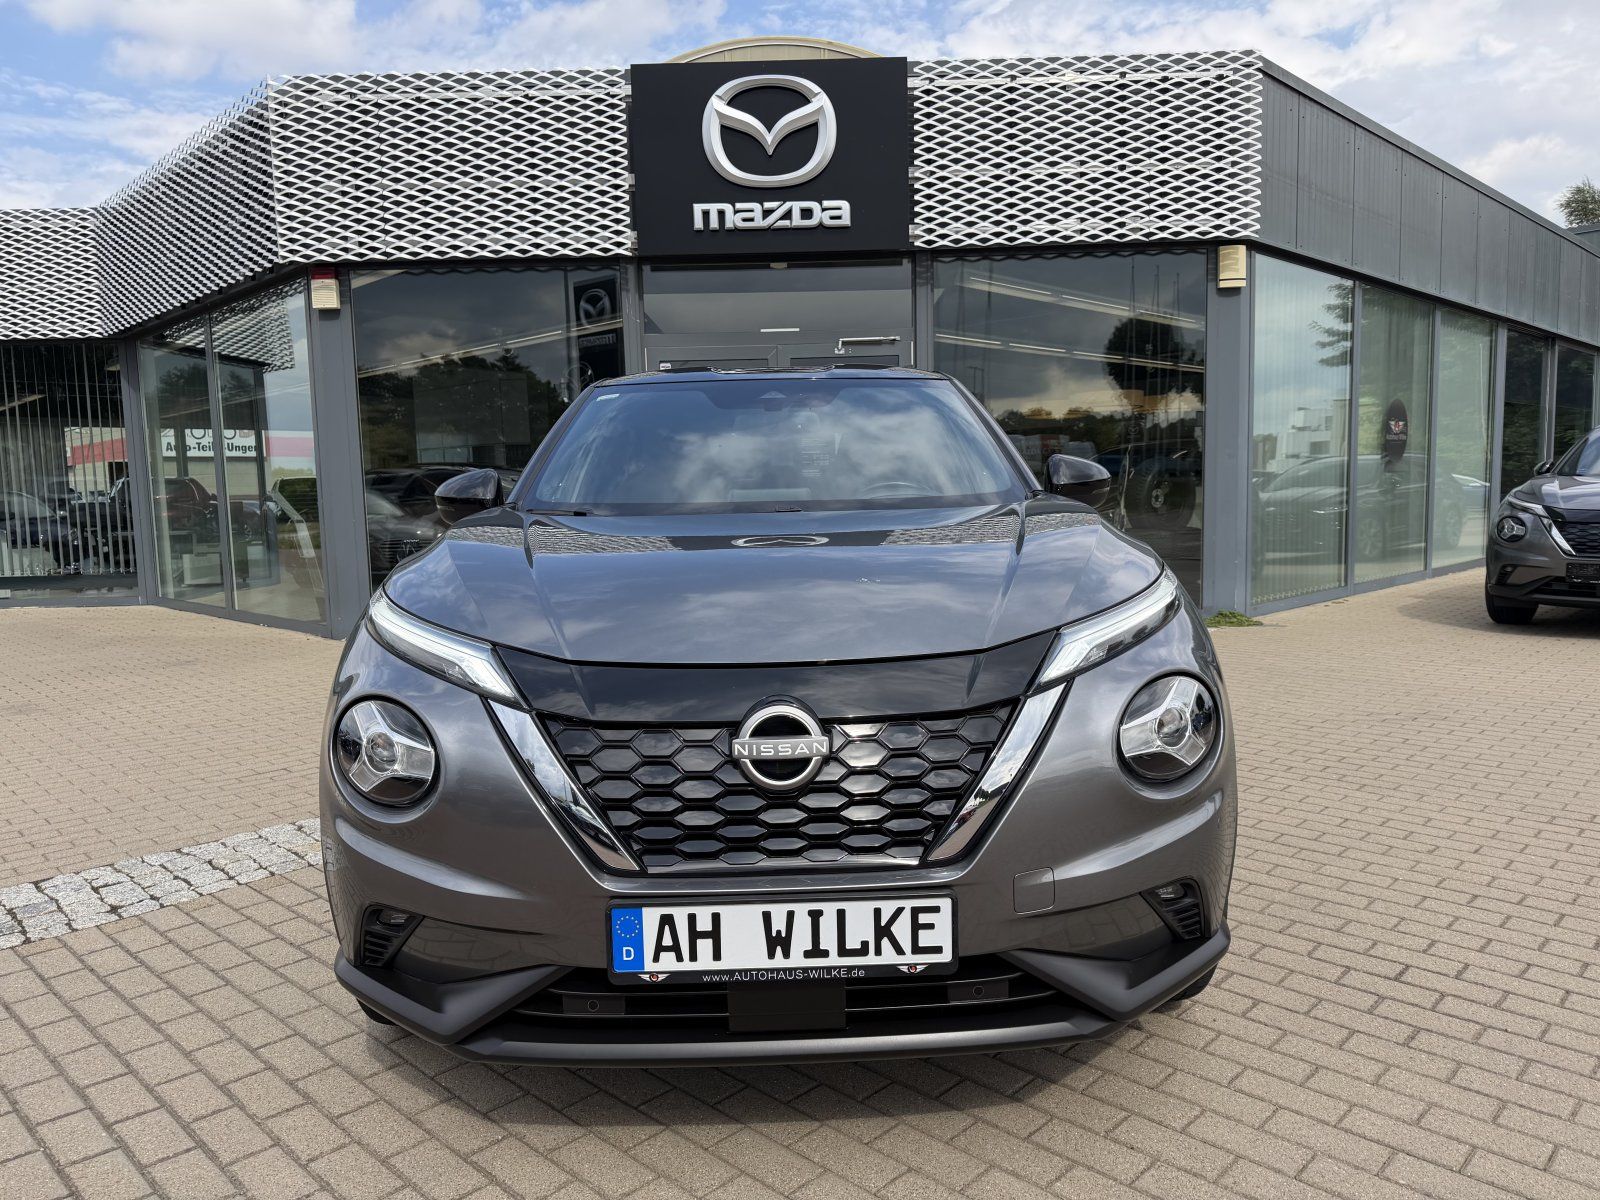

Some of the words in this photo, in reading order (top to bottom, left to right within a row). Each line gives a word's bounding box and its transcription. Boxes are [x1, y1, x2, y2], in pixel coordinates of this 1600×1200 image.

[693, 200, 852, 231] mazda
[166, 441, 257, 454] Ao-TeilUnger
[734, 741, 827, 756] NISSAN
[652, 911, 722, 964] AH
[761, 905, 944, 960] WILKE
[622, 946, 635, 962] D
[702, 967, 866, 983] www.AUTOHAUS-WILKE.de
